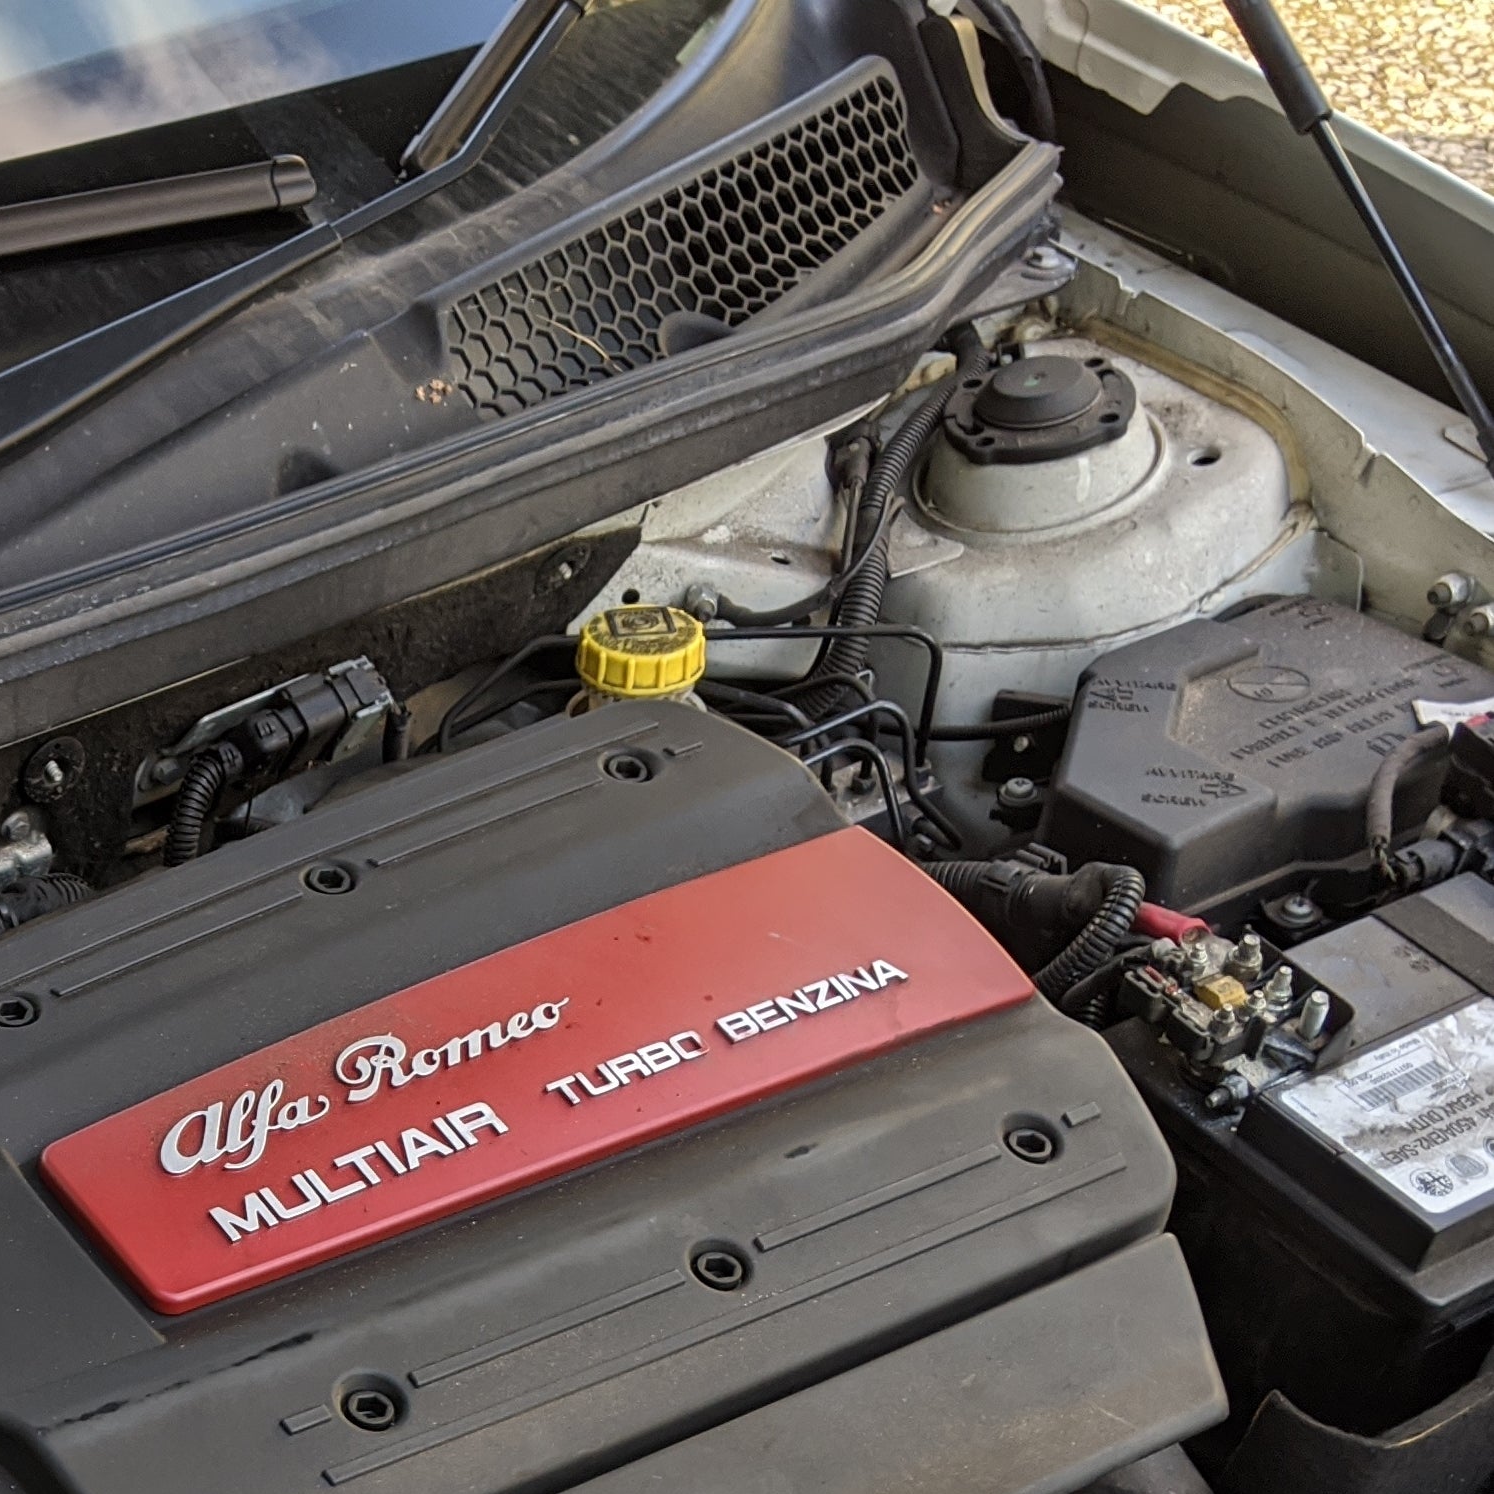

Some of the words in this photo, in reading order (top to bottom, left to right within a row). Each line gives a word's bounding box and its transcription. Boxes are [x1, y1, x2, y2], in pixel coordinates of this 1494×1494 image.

[159, 1078, 331, 1174] Alfa
[335, 996, 570, 1102] Romeo
[208, 1101, 509, 1243] MULTIAIR
[546, 1030, 709, 1106] TURBO
[714, 959, 908, 1044] BENZINA
[1406, 1109, 1443, 1133] DUTY
[1442, 1089, 1482, 1116] HEAVY
